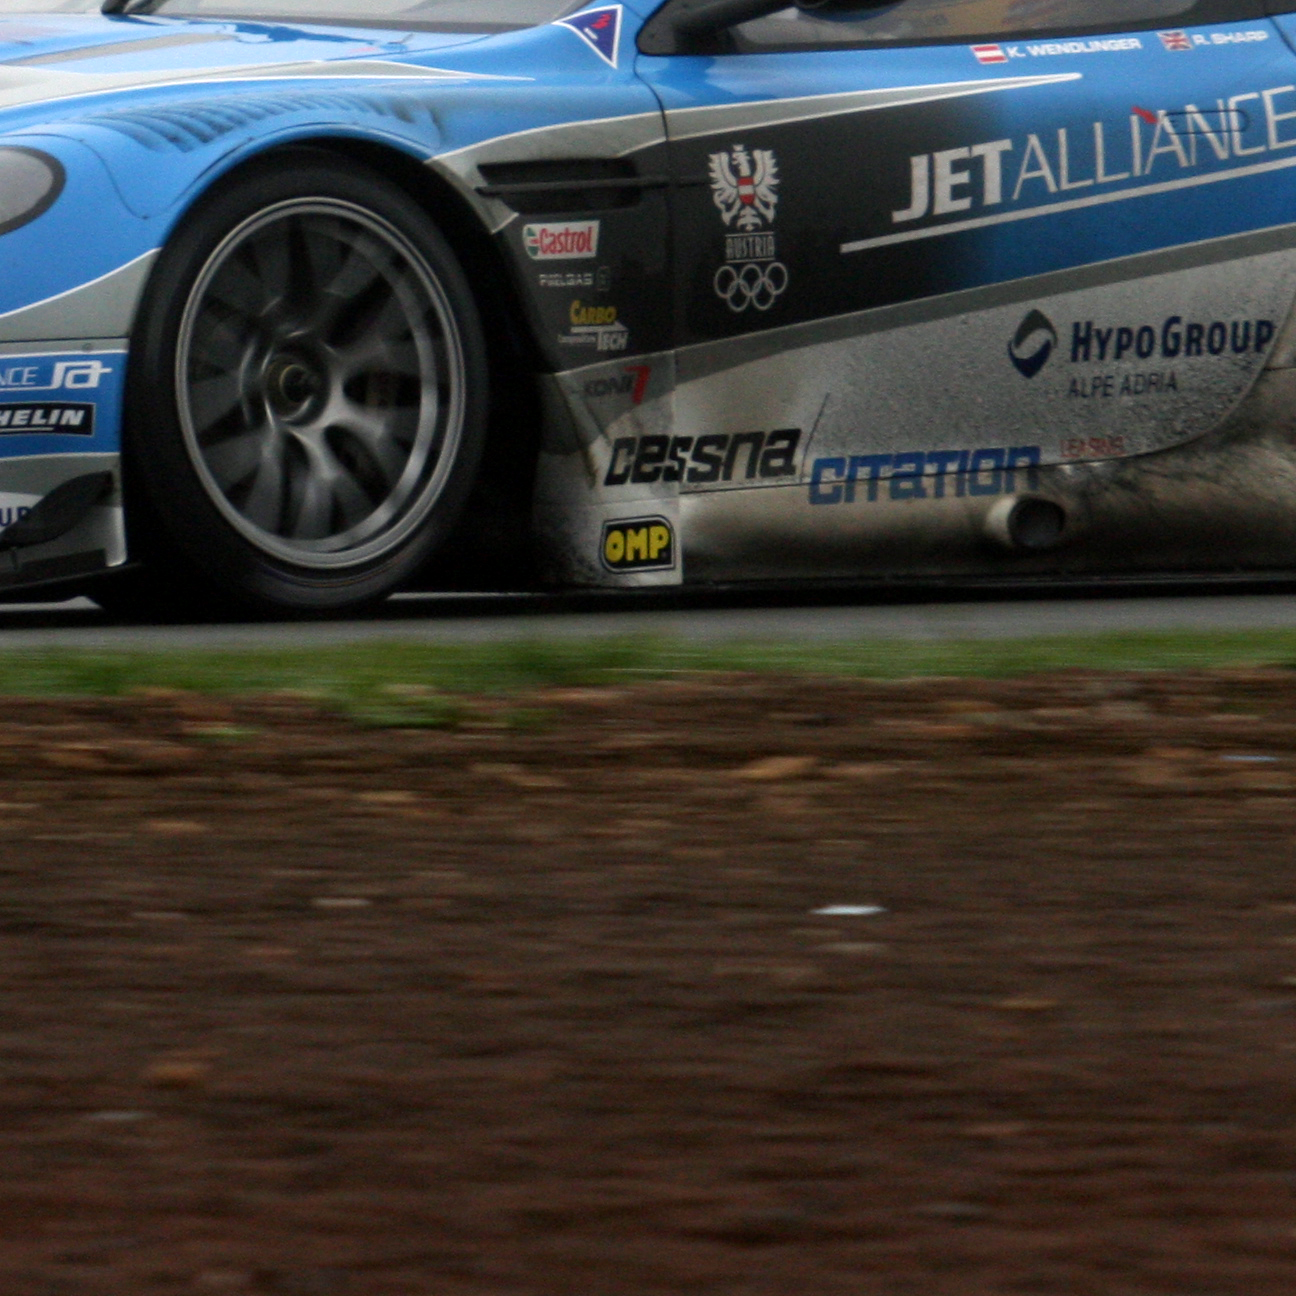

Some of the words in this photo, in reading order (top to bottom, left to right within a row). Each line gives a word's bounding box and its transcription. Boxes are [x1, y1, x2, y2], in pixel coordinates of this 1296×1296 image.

[1026, 38, 1143, 57] WENDLINGER
[539, 226, 594, 255] Castrol
[725, 235, 775, 259] AUSTRIA
[1068, 375, 1114, 399] ALPE
[1118, 371, 1178, 396] ADRIA
[604, 428, 803, 486] cessna
[605, 525, 670, 564] OMP
